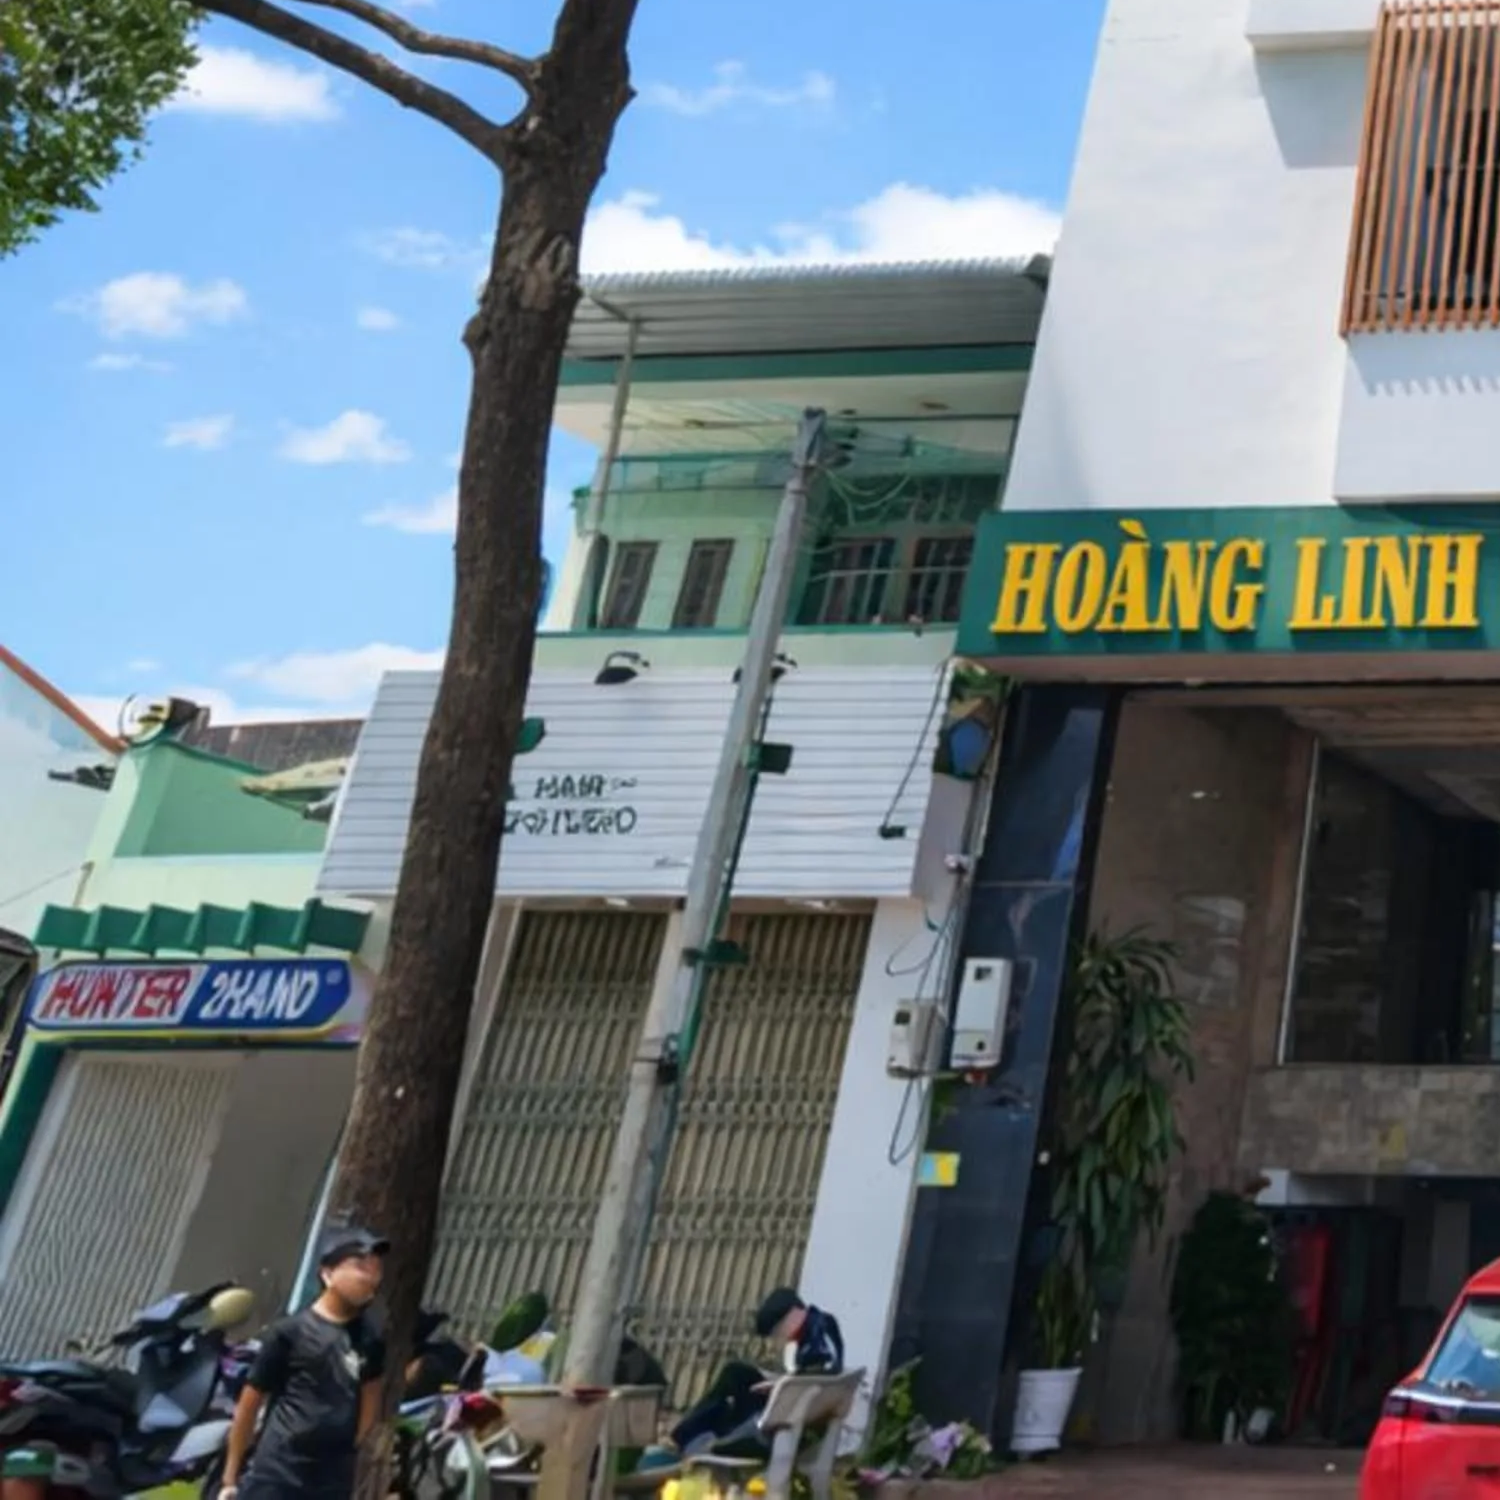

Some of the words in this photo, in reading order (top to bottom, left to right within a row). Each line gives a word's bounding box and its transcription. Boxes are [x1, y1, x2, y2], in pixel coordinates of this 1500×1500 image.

[990, 519, 1266, 633] HOÀNG
[1287, 534, 1484, 628] LINH
[38, 968, 193, 1019] HUNTER
[198, 968, 318, 1020] 2HAND
